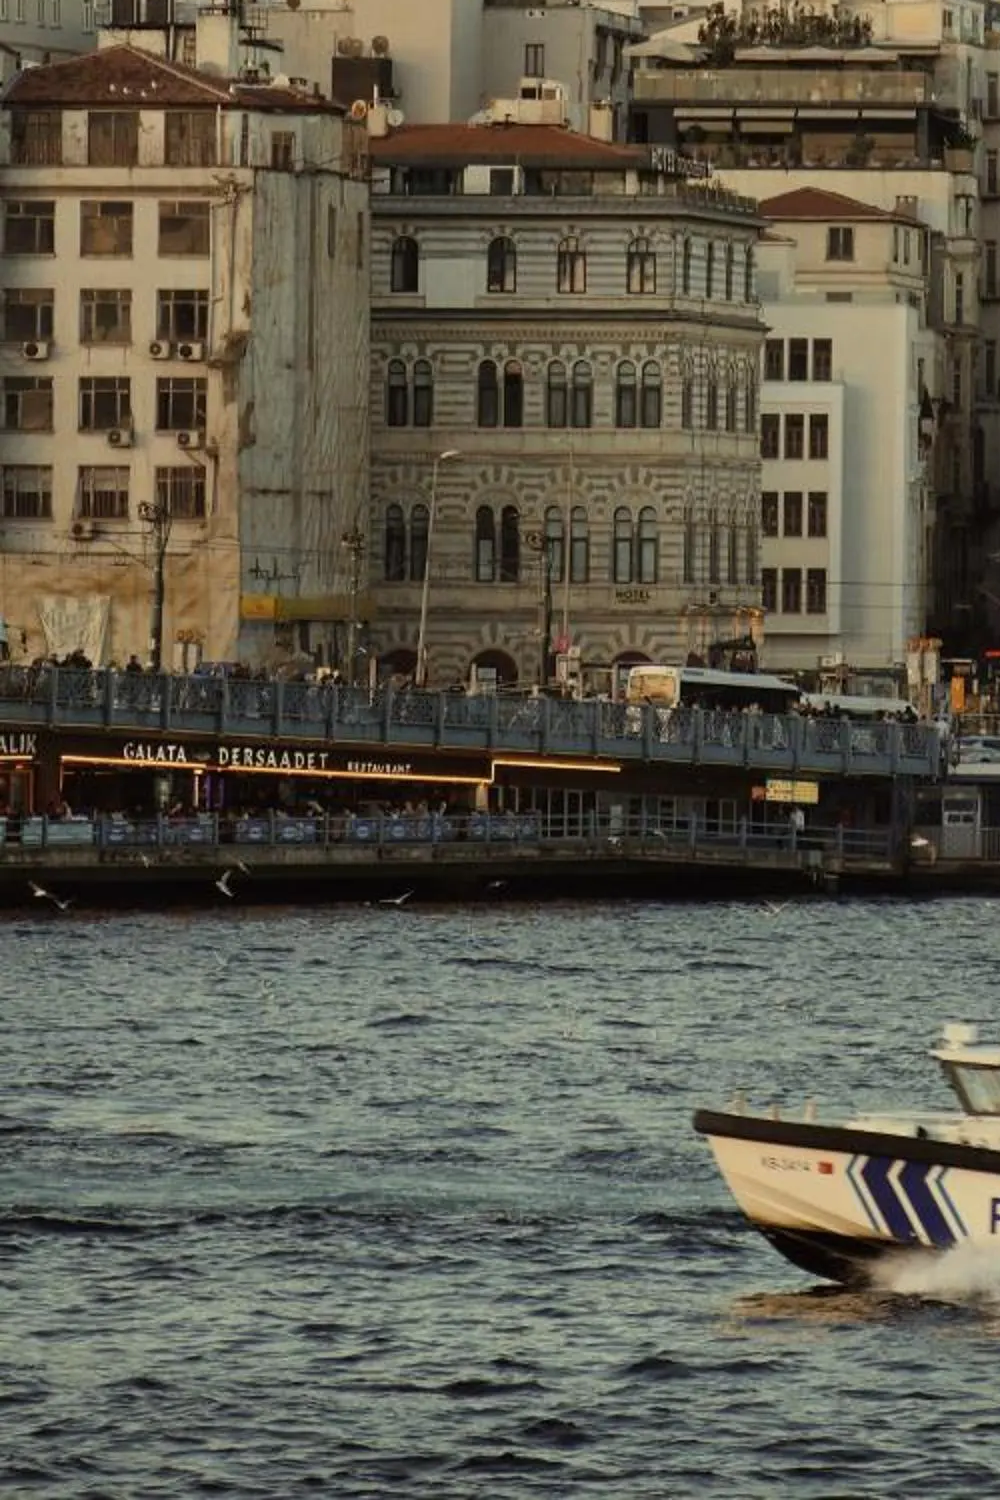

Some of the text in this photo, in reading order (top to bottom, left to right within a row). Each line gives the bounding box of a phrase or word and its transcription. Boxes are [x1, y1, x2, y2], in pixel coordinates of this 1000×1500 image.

[123, 742, 411, 773] GALATA DERSAADET RESTAURANT
